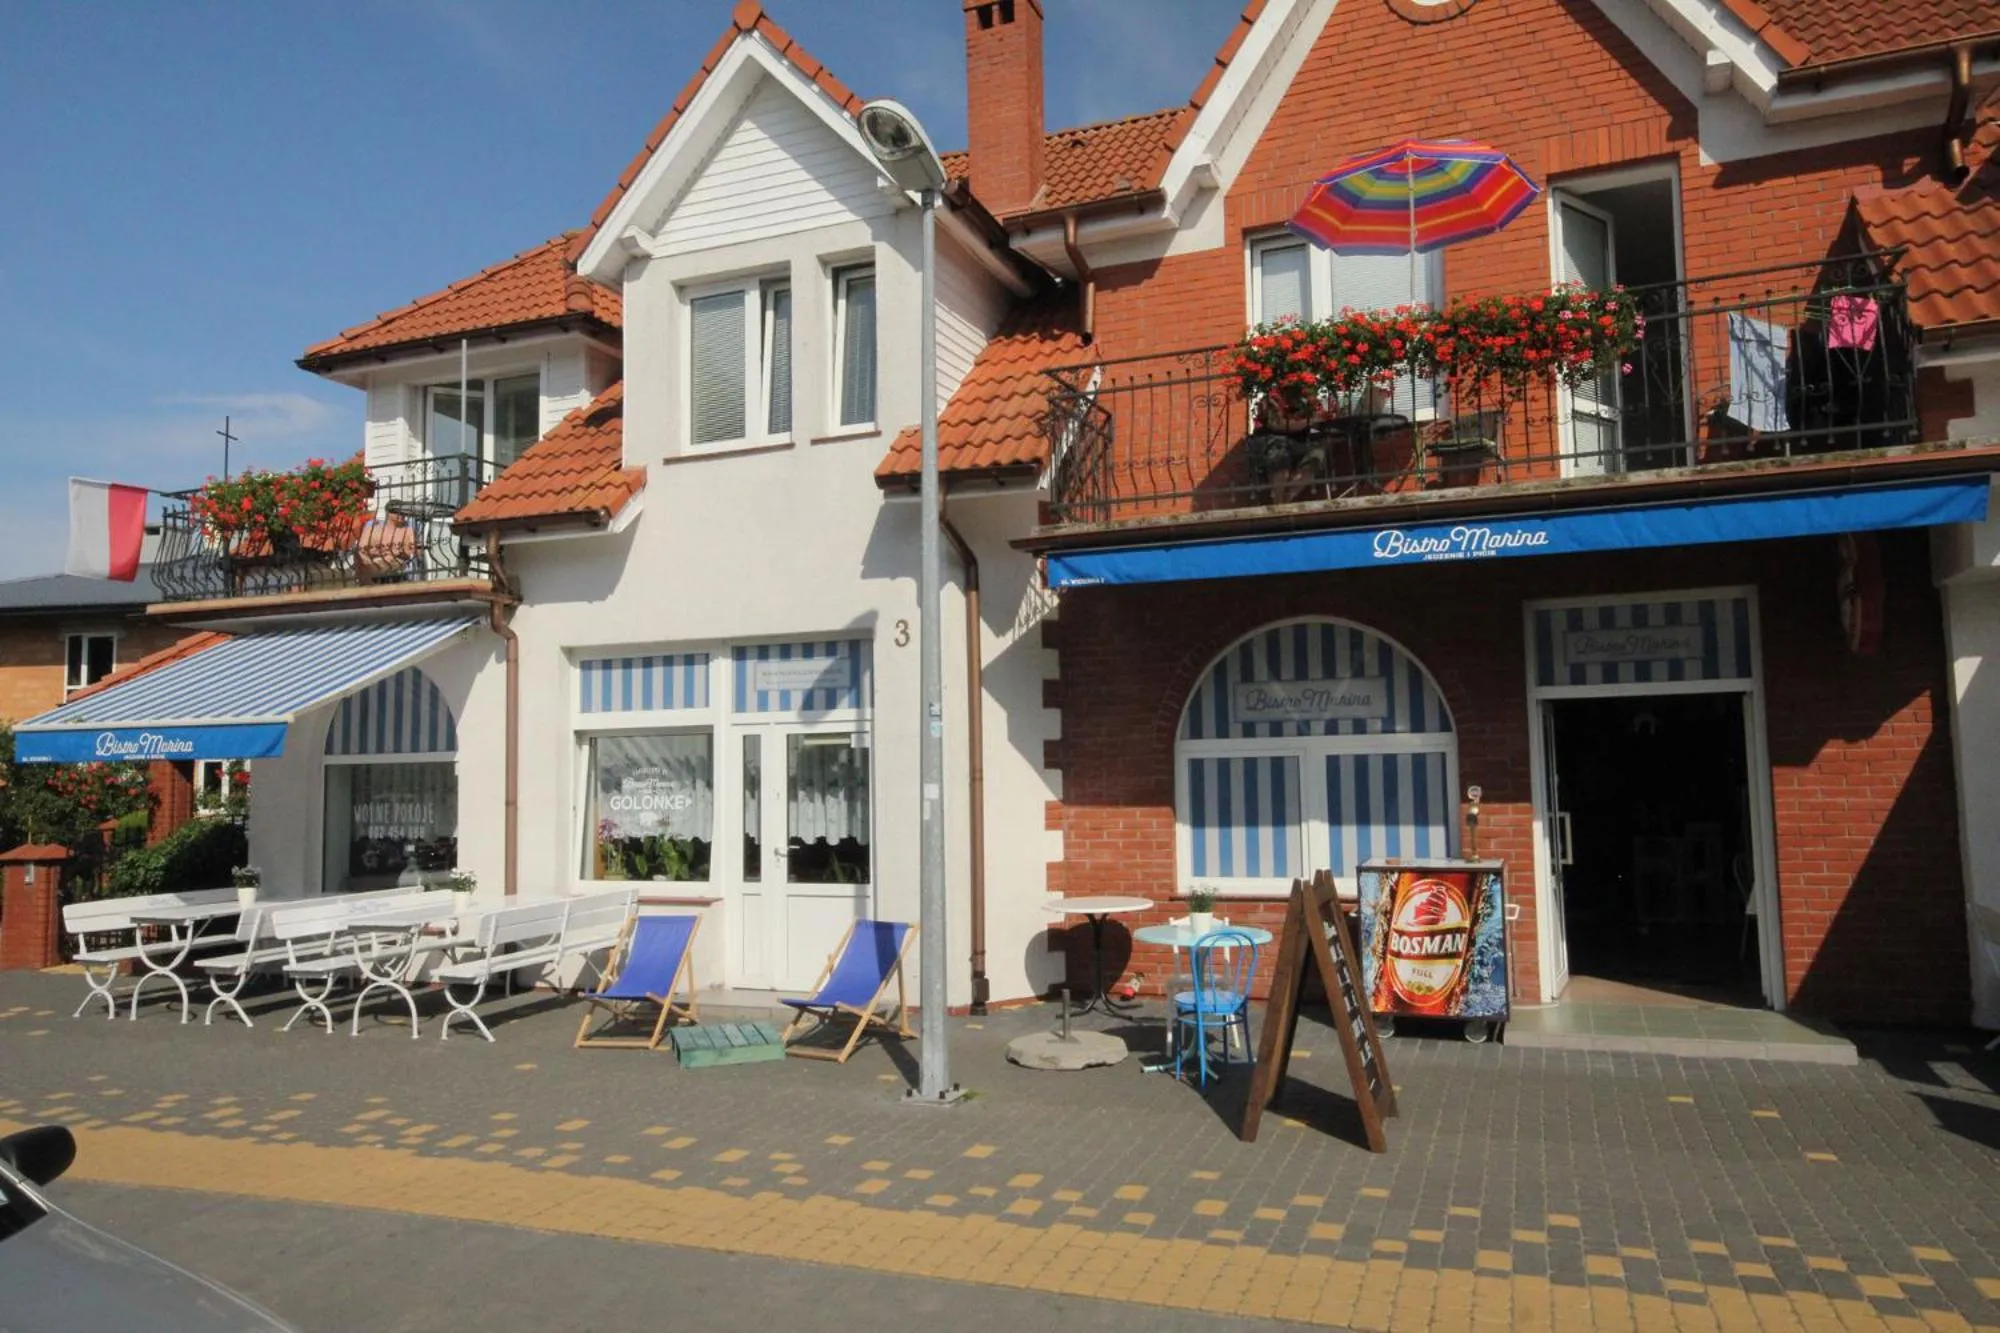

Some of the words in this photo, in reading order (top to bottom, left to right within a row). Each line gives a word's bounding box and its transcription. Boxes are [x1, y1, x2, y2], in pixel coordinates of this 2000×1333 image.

[1373, 529, 1450, 558] Bistro
[1450, 525, 1549, 551] Marina
[894, 619, 911, 648] 3
[1246, 688, 1301, 711] Bistro
[1301, 686, 1373, 712] Marina
[96, 732, 139, 756] Bistro
[139, 732, 193, 754] Marina
[353, 803, 390, 824] WOLNE
[1391, 932, 1468, 955] BOSMAN
